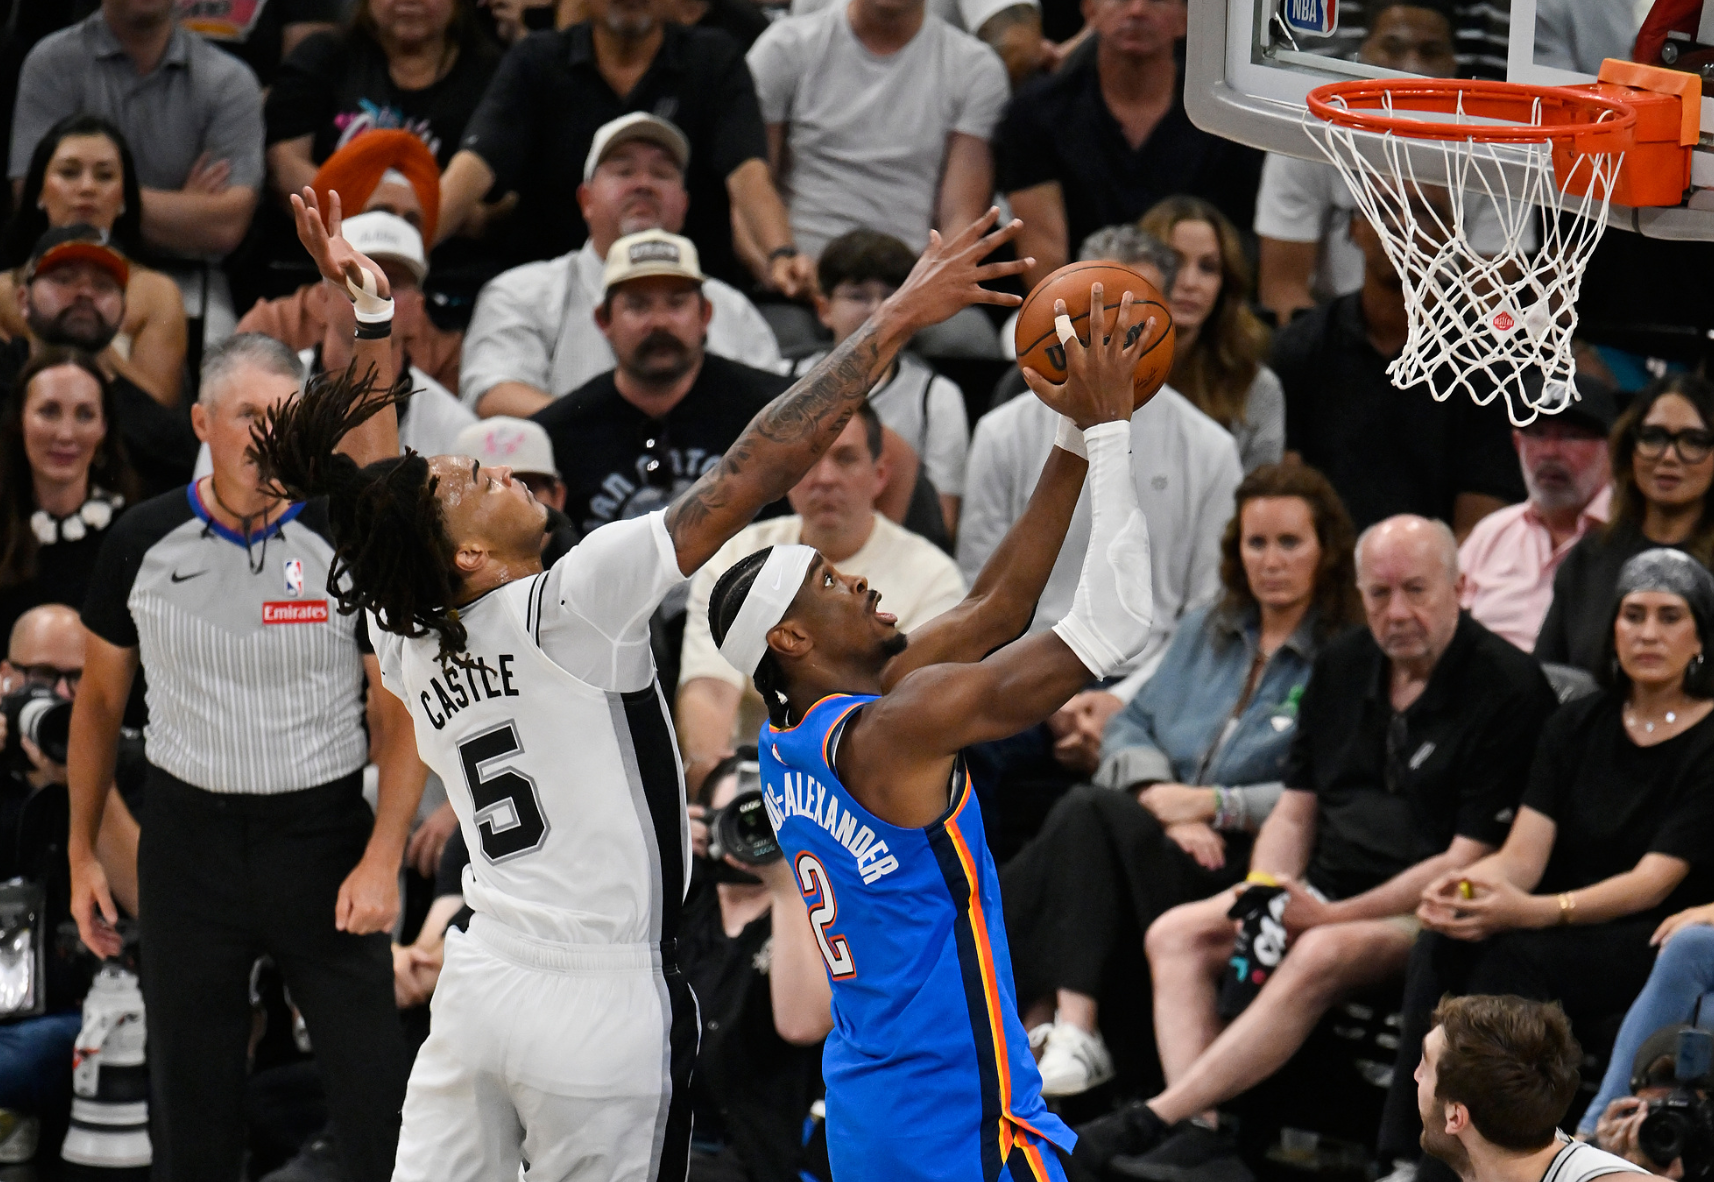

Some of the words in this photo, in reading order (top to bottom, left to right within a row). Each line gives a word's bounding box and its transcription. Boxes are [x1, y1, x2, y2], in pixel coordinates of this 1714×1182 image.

[1292, 0, 1317, 23] NBA
[264, 604, 327, 621] Emirates
[420, 654, 520, 731] CASTLE
[455, 718, 551, 866] 5
[763, 771, 899, 886] US-ALEXANDER
[795, 850, 857, 981] 2
